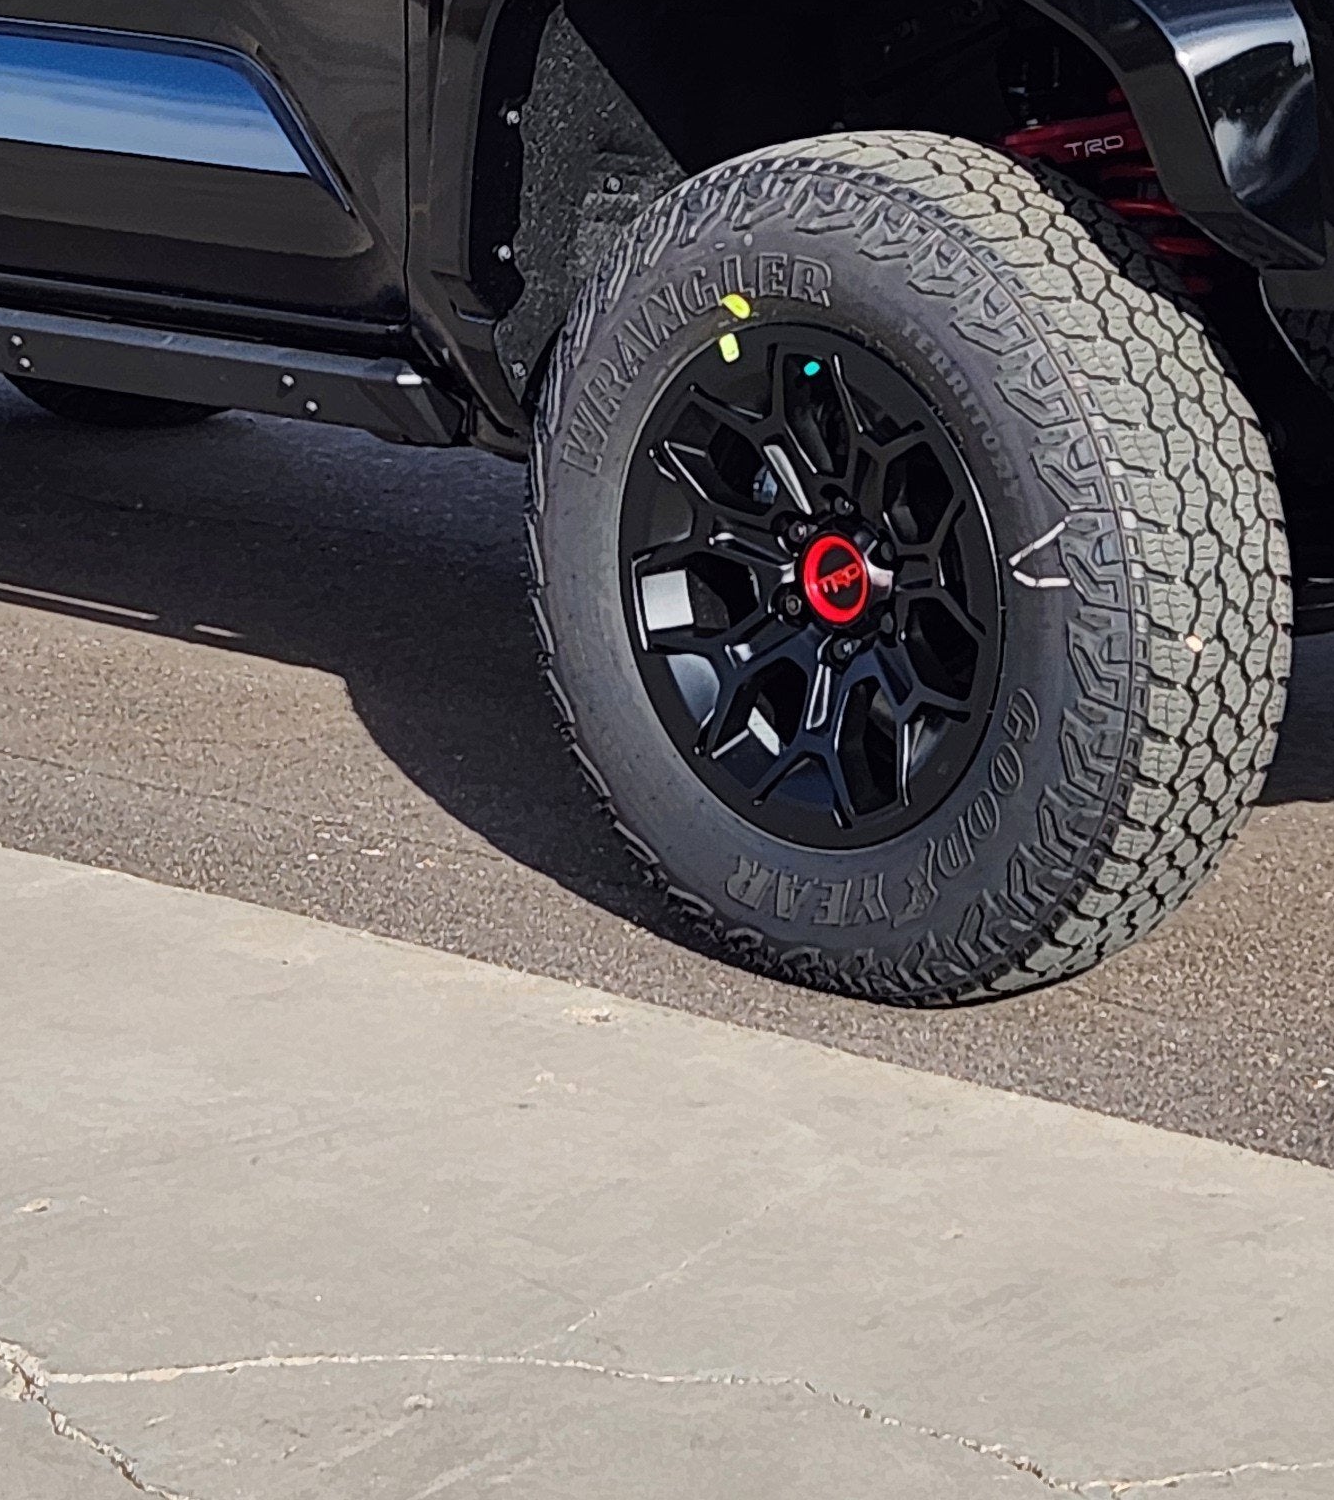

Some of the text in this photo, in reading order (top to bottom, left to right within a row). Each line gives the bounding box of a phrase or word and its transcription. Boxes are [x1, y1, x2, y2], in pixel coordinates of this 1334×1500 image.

[1064, 135, 1124, 158] TRD
[561, 251, 832, 477] WRANGLER
[901, 316, 1024, 500] TERRITORY
[818, 562, 861, 594] TRD
[725, 688, 1041, 928] GOODYEAR
